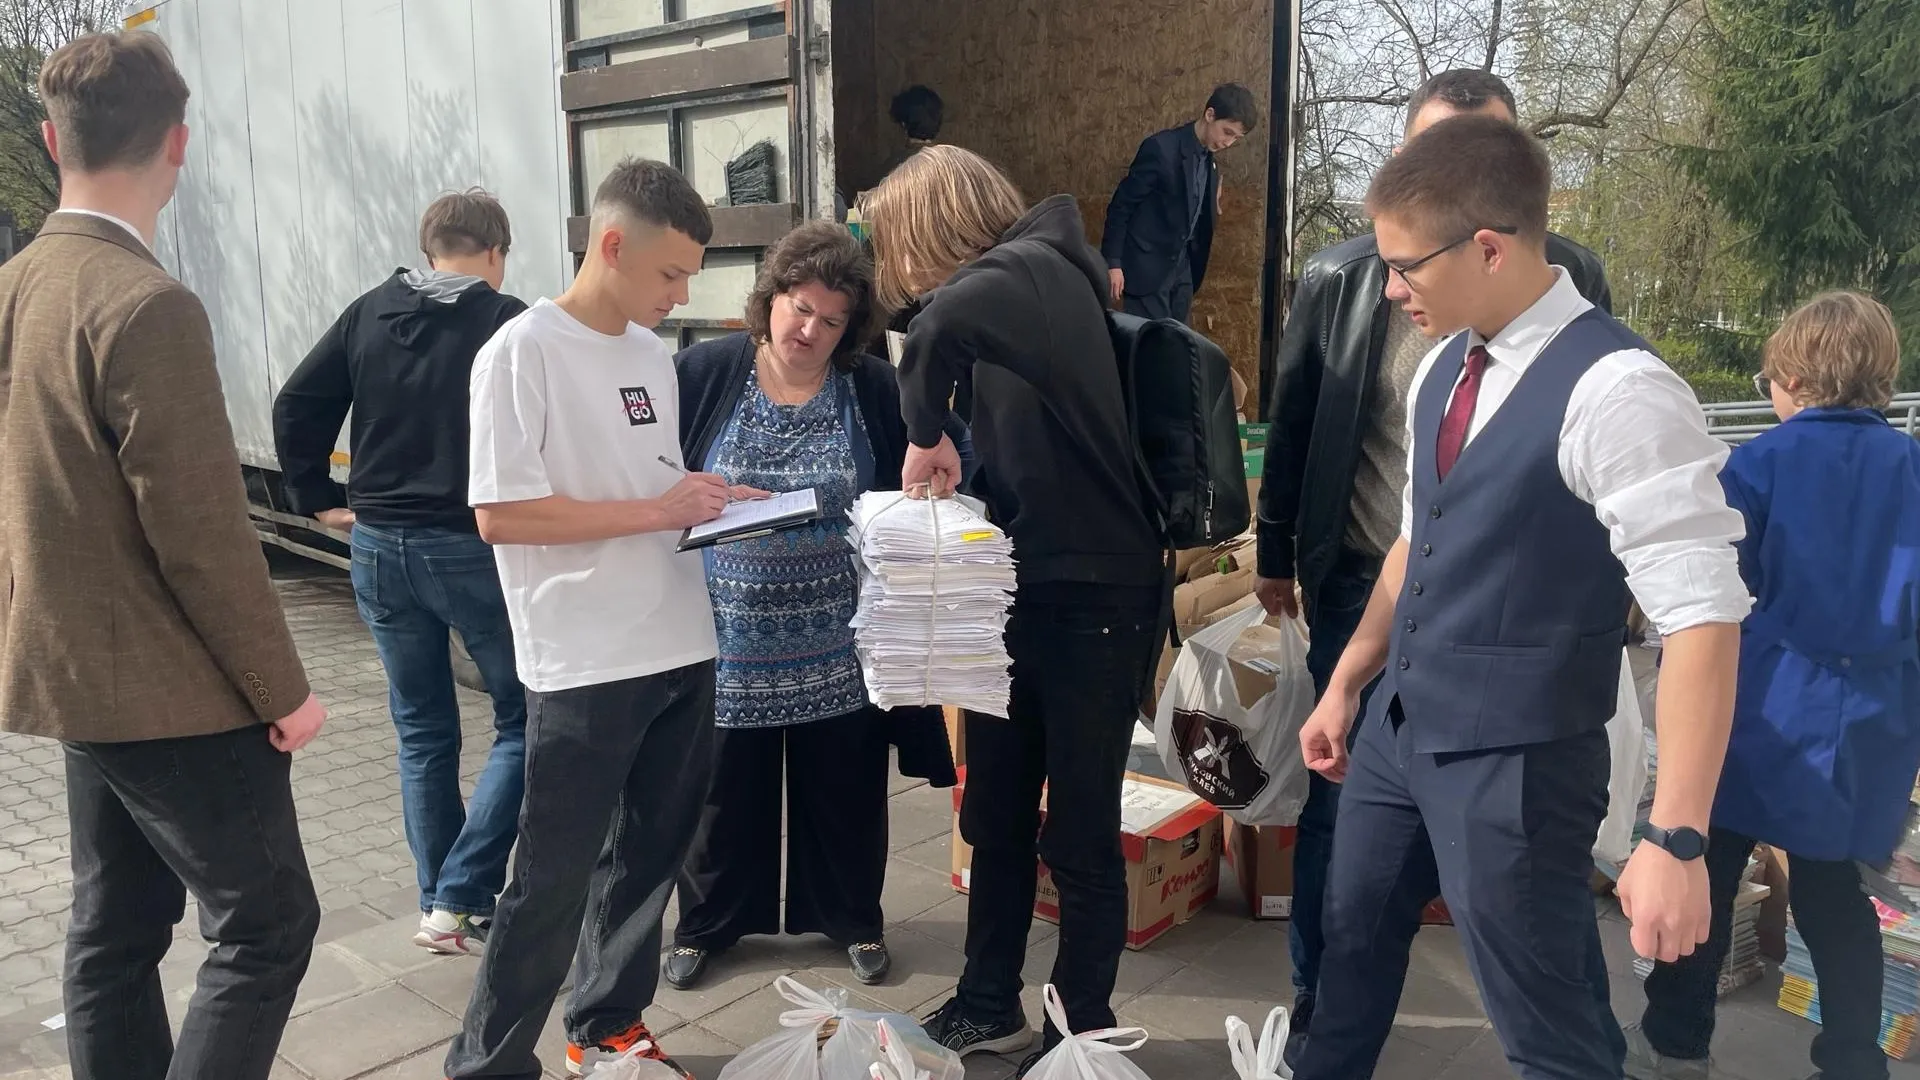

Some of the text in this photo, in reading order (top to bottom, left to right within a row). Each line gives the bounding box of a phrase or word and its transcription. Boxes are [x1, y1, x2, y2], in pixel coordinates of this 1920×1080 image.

[625, 391, 645, 405] HU
[630, 405, 651, 420] GO
[1193, 774, 1216, 795] ХЛЕБ
